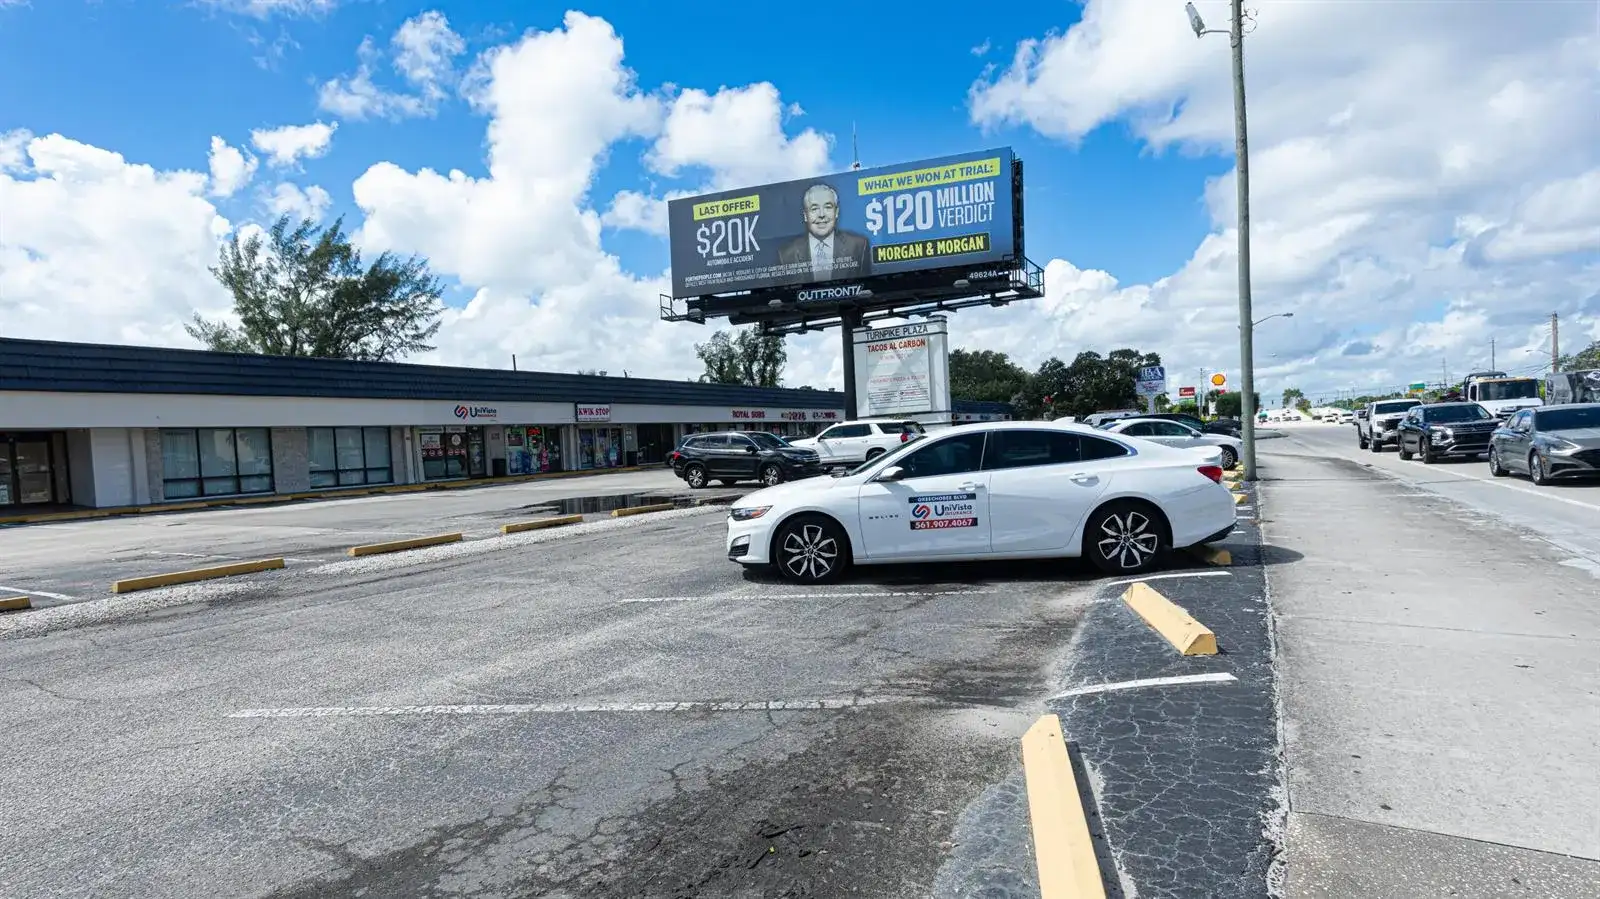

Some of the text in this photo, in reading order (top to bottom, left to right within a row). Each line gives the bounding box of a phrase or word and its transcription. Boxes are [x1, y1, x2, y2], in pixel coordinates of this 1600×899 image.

[864, 164, 993, 191] WHAT WE WON AT TRIAL:
[699, 200, 754, 216] LAST OFFER:
[865, 181, 995, 236] $120 MILLION
[938, 202, 995, 228] VERDICT
[696, 214, 760, 258] $20K
[877, 235, 985, 261] MORGAN & MORGAN
[733, 254, 754, 263] ACCIDENT
[969, 270, 998, 279] 49624A
[865, 324, 928, 341] TURNPIKE PLAZA
[867, 338, 926, 353] TACOS AL CARBON
[578, 408, 610, 416] KWIK STOP
[934, 504, 973, 516] UniVista
[915, 519, 973, 529] 561.907.4067
